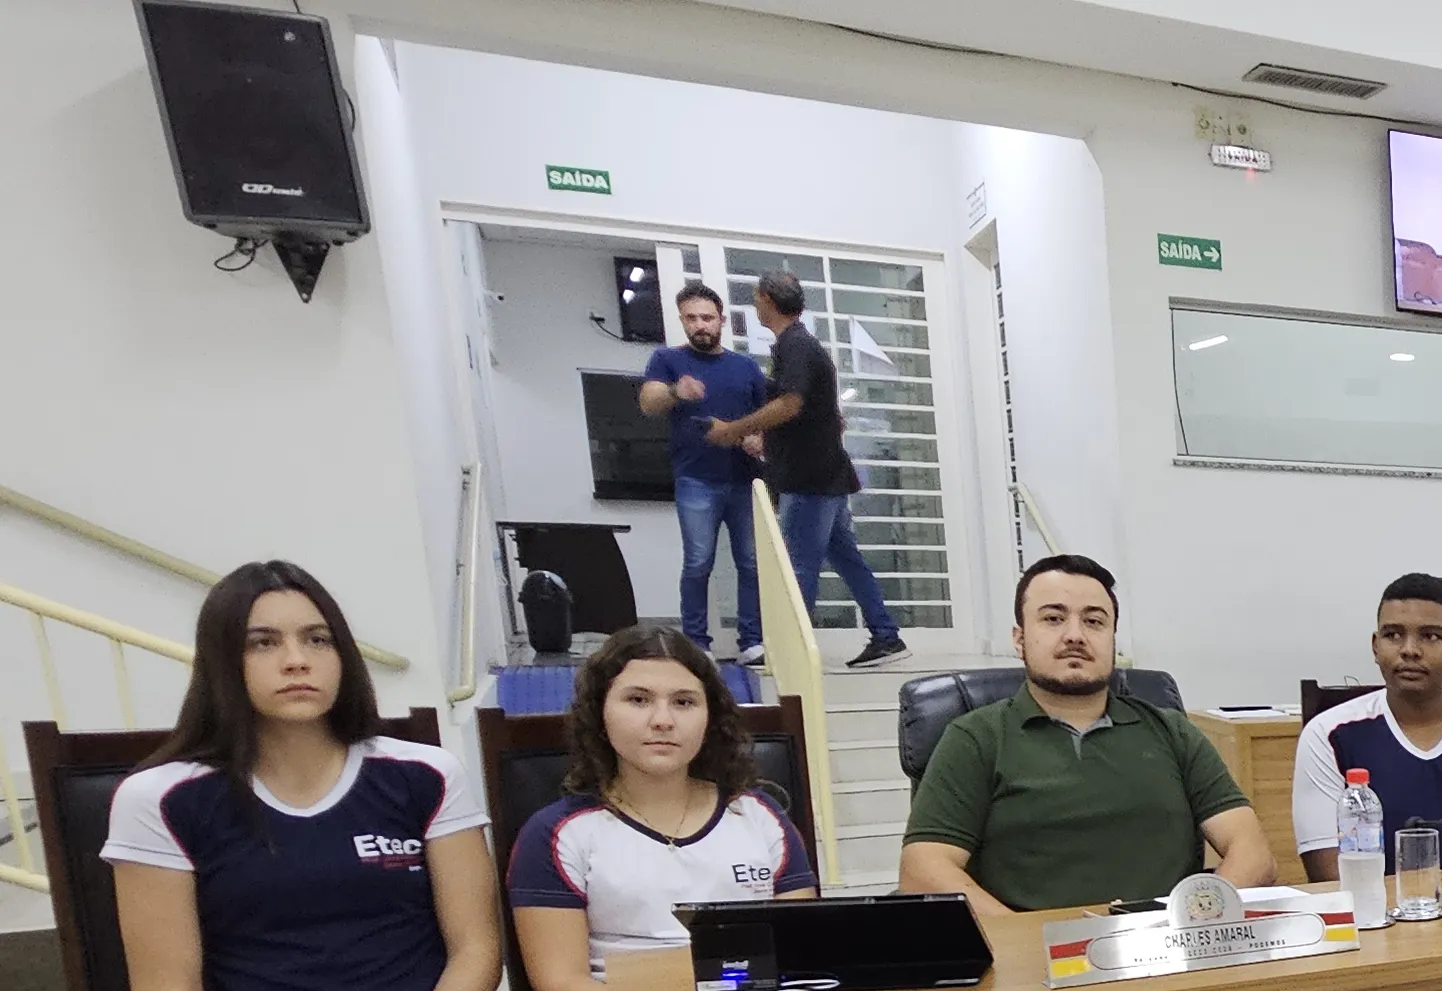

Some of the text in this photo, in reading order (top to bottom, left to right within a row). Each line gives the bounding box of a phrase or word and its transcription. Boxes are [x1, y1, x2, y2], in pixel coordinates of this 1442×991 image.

[548, 170, 609, 189] SAÍDA
[1160, 240, 1202, 261] SAÍDA
[353, 834, 421, 858] Etec
[731, 863, 771, 883] Ete
[1165, 925, 1256, 949] CHARLES AMARAL
